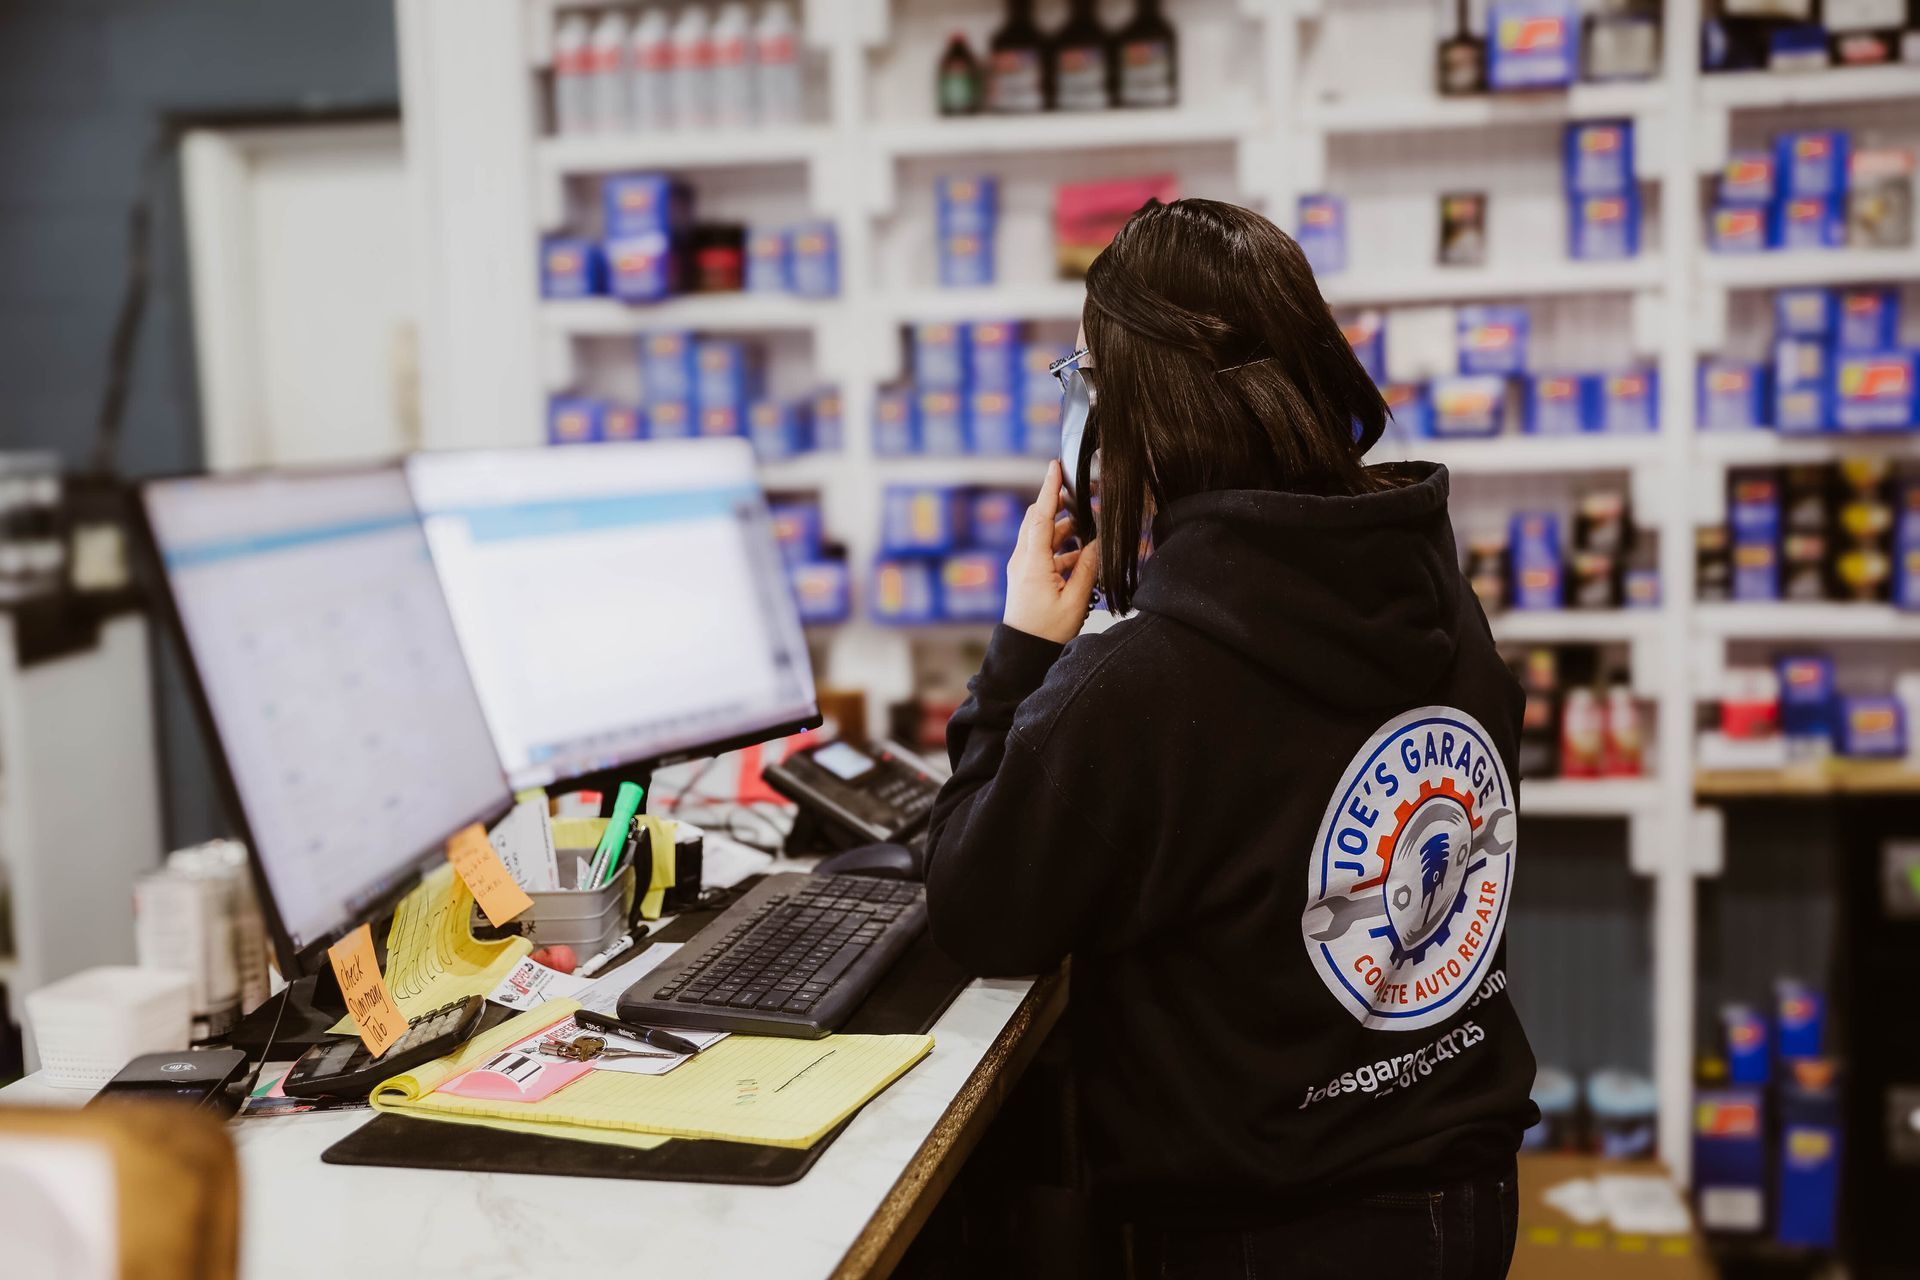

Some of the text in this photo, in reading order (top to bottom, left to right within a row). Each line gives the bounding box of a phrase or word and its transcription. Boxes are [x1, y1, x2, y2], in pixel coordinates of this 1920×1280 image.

[1334, 731, 1494, 877] JOE'S GARAGE
[1415, 958, 1461, 1002] AUTO
[1457, 880, 1497, 963] REPAIR
[362, 1015, 388, 1048] Tab
